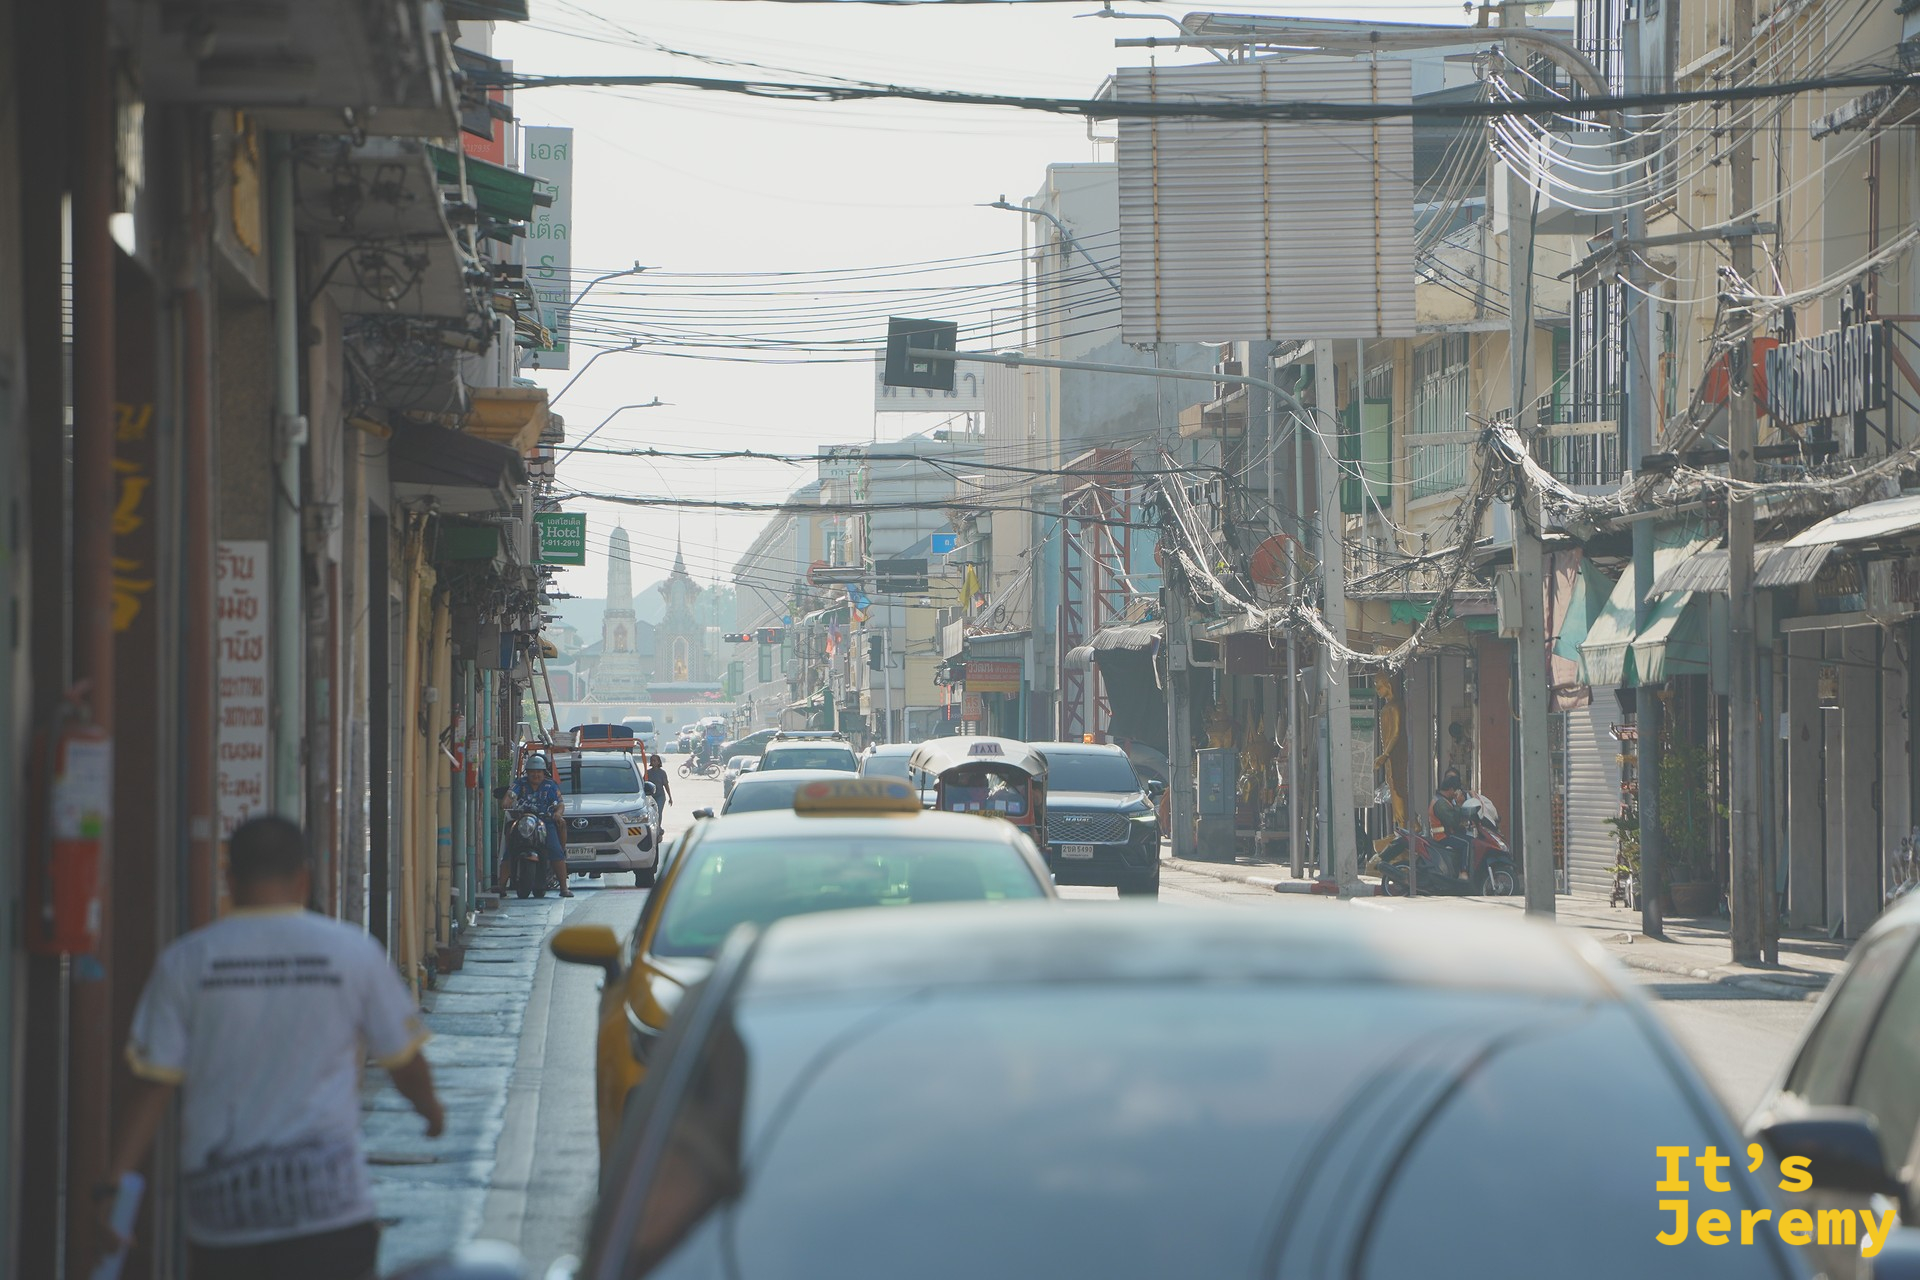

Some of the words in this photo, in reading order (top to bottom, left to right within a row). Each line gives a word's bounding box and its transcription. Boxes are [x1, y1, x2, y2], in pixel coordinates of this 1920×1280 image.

[530, 143, 568, 161] เอส
[539, 254, 555, 278] S
[535, 288, 567, 303] otel
[546, 526, 581, 538] Hotel
[975, 745, 999, 754] TAXI
